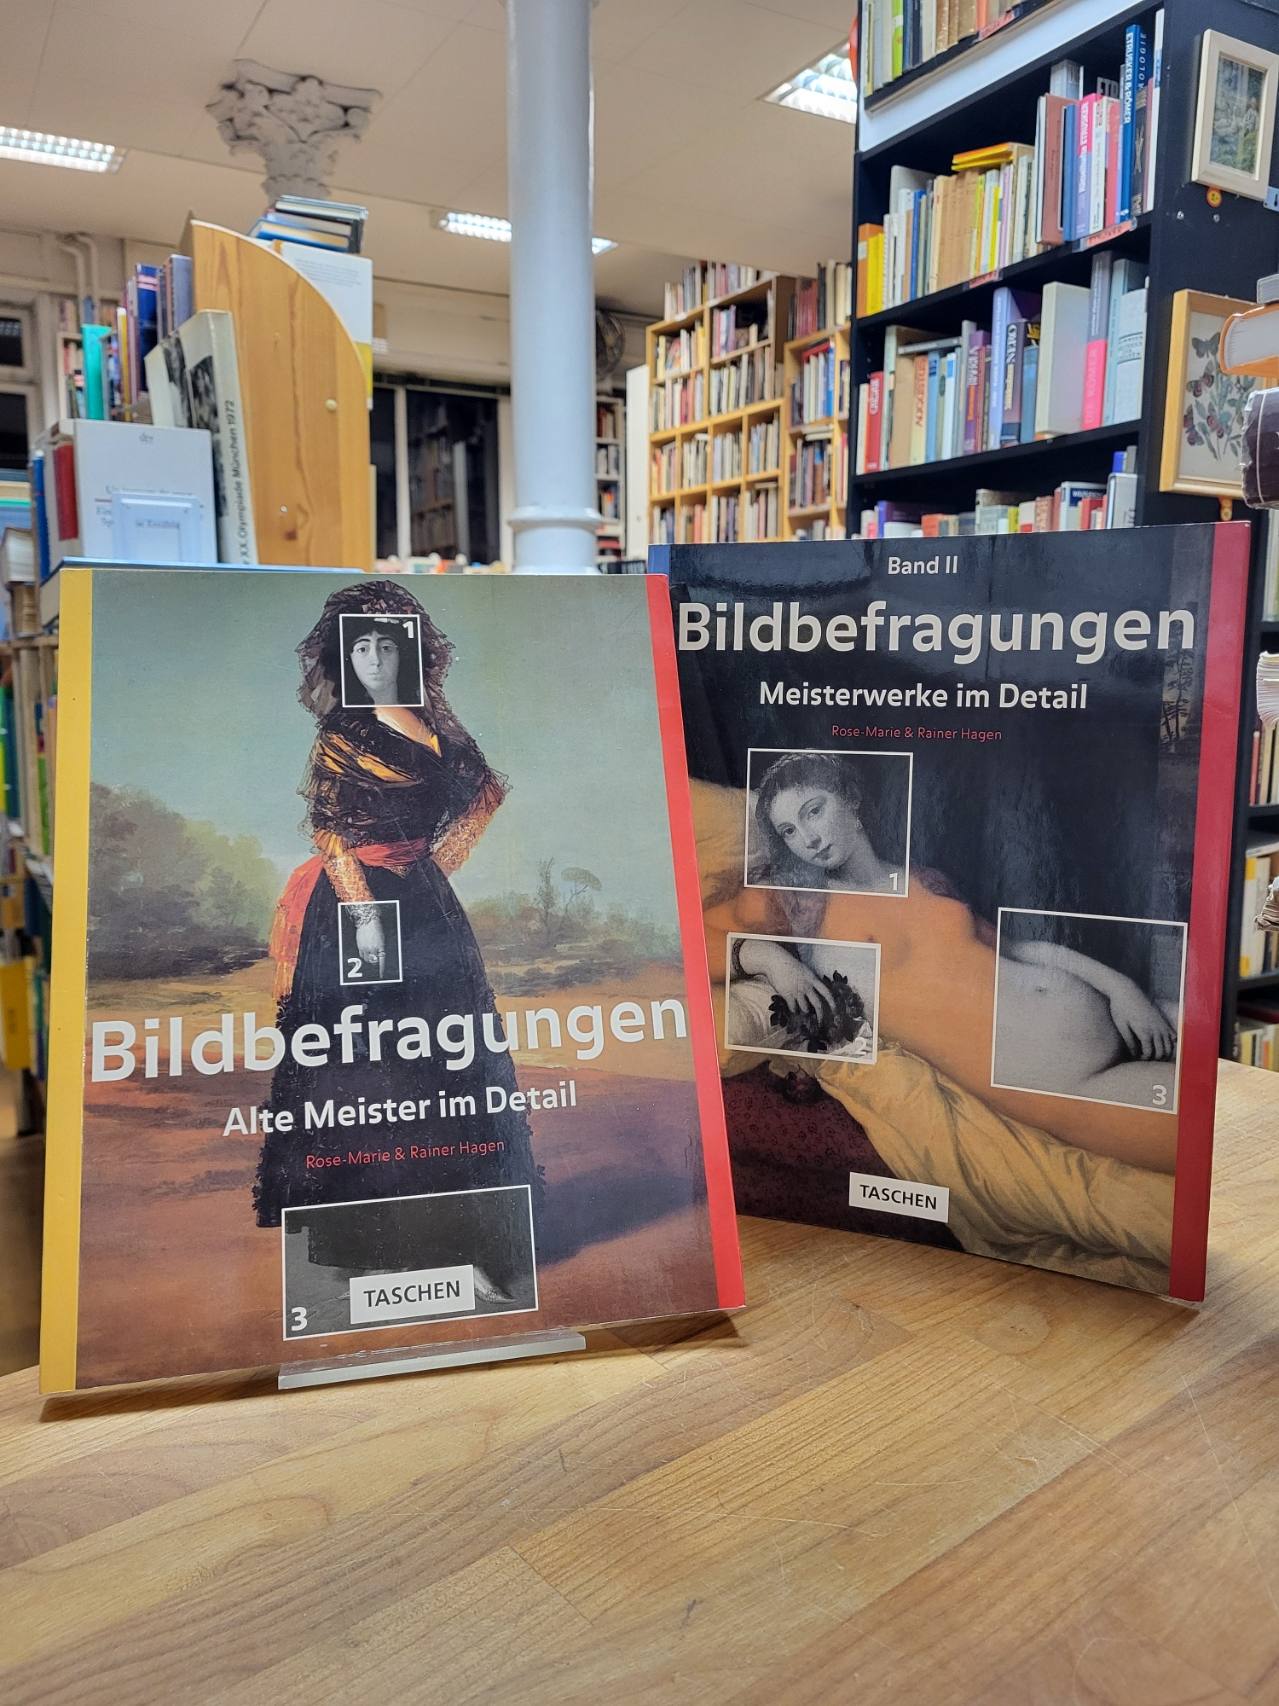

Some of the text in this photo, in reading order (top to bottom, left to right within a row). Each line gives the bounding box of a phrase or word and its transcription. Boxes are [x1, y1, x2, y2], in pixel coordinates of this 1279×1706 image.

[1125, 32, 1133, 79] ETRUSKER
[224, 399, 236, 425] 1972
[229, 429, 241, 477] München
[234, 481, 248, 538] Olympiade
[887, 555, 958, 575] Band II
[402, 620, 414, 639] 1
[678, 601, 1195, 665] Bildbefragungen
[759, 681, 1088, 710] Meisterwerke im Detail
[831, 725, 1002, 742] Rose-Marie & Rainer Hagen
[889, 872, 899, 891] 1
[347, 957, 363, 978] 2
[90, 998, 688, 1083] Bildbefragungen
[222, 1080, 578, 1137] Alte Meister im Detail
[1152, 1084, 1168, 1106] 3
[306, 1139, 506, 1169] Rose-Marie & Rainer Hagen
[860, 1184, 938, 1210] TASCHEN
[363, 1280, 461, 1308] TASCHEN
[291, 1306, 308, 1332] 3
